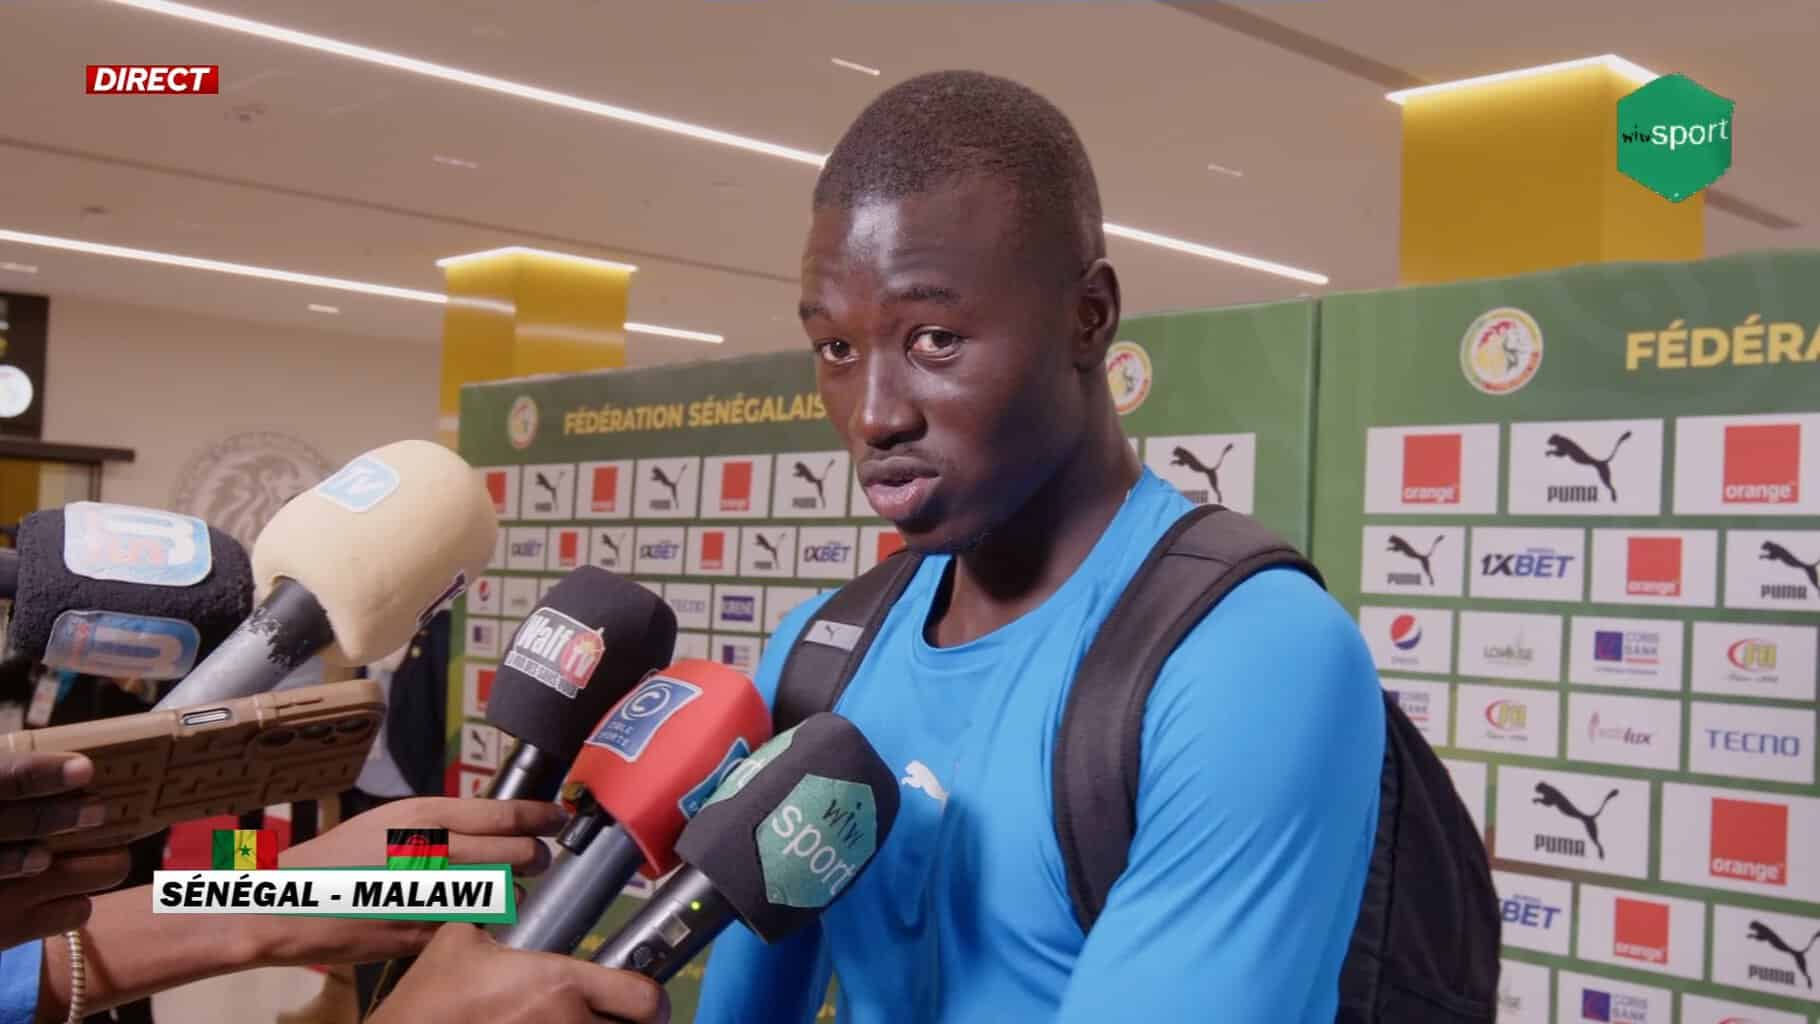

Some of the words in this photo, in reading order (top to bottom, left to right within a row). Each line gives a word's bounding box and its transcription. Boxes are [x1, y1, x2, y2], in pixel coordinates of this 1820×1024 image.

[564, 404, 683, 435] FÉDÉRATION
[1404, 486, 1455, 503] orange
[1547, 485, 1599, 503] PUMA
[1725, 483, 1792, 504] orange
[1481, 553, 1574, 579] 1XBET
[1760, 584, 1807, 600] PUMA
[1704, 728, 1800, 757] TECNO
[771, 804, 857, 896] sport
[1534, 833, 1585, 857] PUMA
[1712, 857, 1779, 882] orange
[1748, 964, 1796, 986] PUMA
